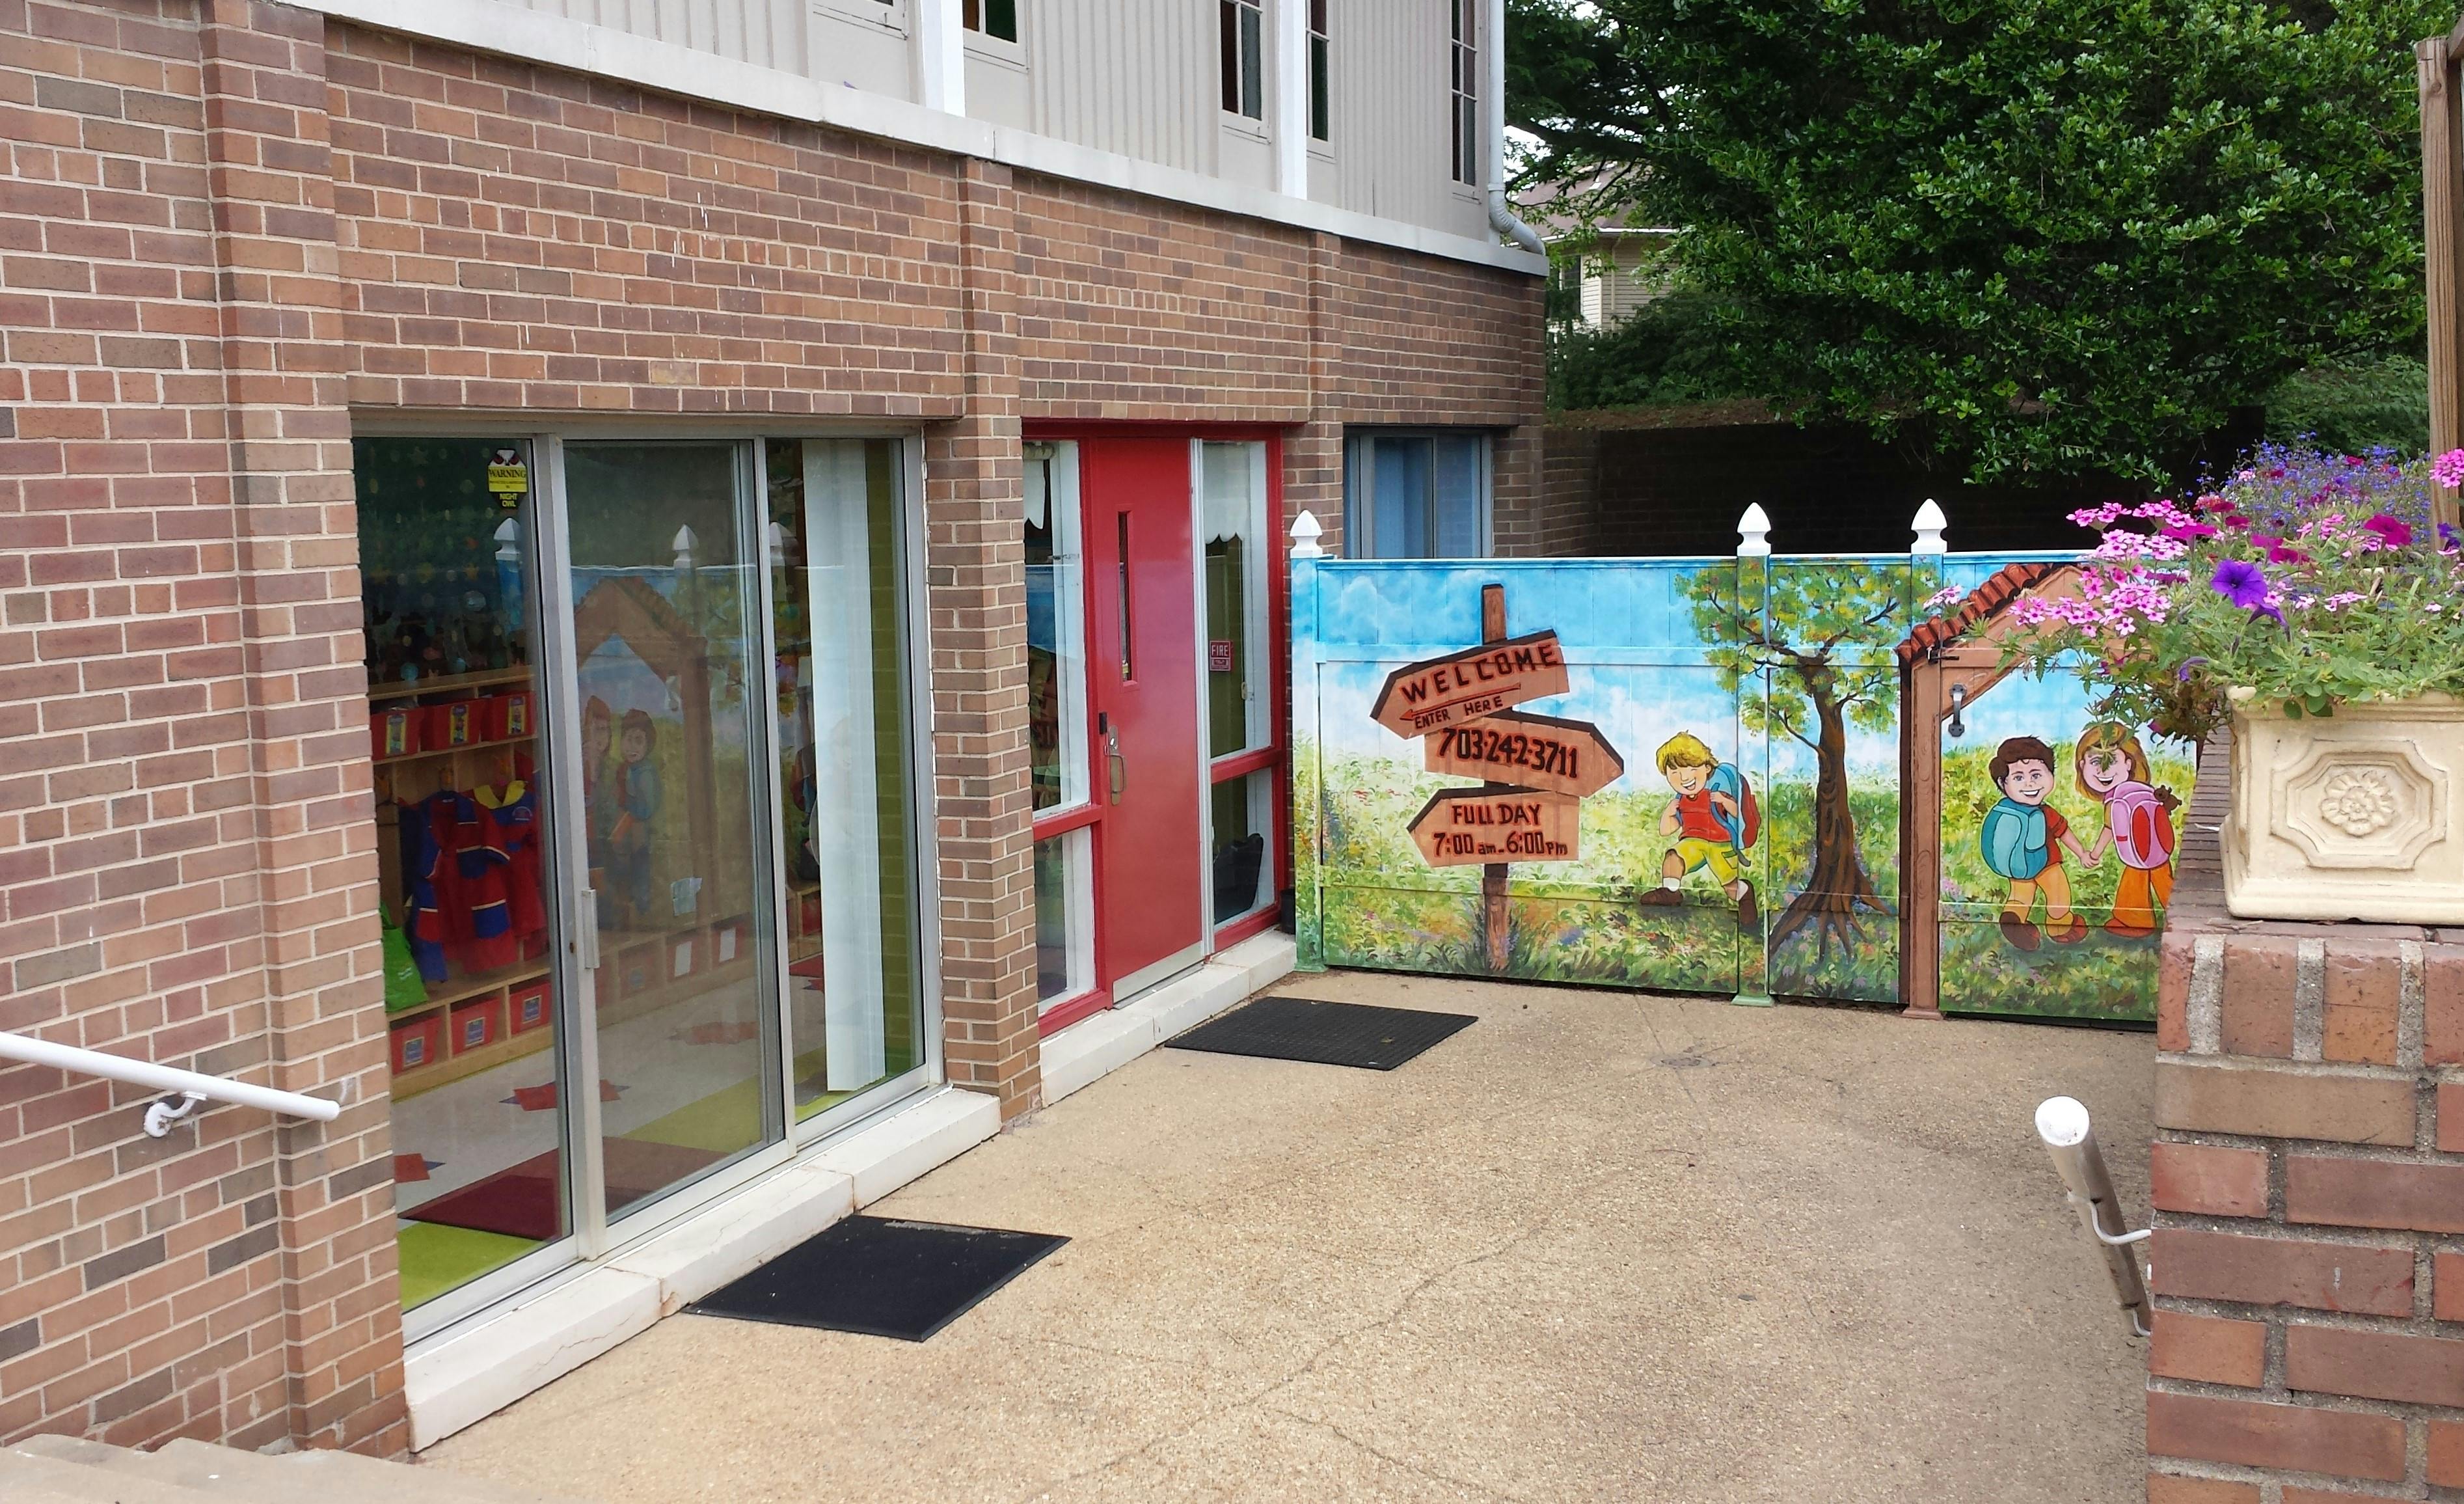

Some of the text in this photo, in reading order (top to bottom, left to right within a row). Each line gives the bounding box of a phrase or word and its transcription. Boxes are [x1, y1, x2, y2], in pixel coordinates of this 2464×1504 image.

[488, 469, 526, 478] WARNING
[1212, 645, 1228, 657] FIRE
[1401, 644, 1558, 703] WELCOME
[1415, 696, 1504, 730] ENTER HERE
[1452, 804, 1541, 825] FULL DAY
[1433, 832, 1474, 856] 7:00
